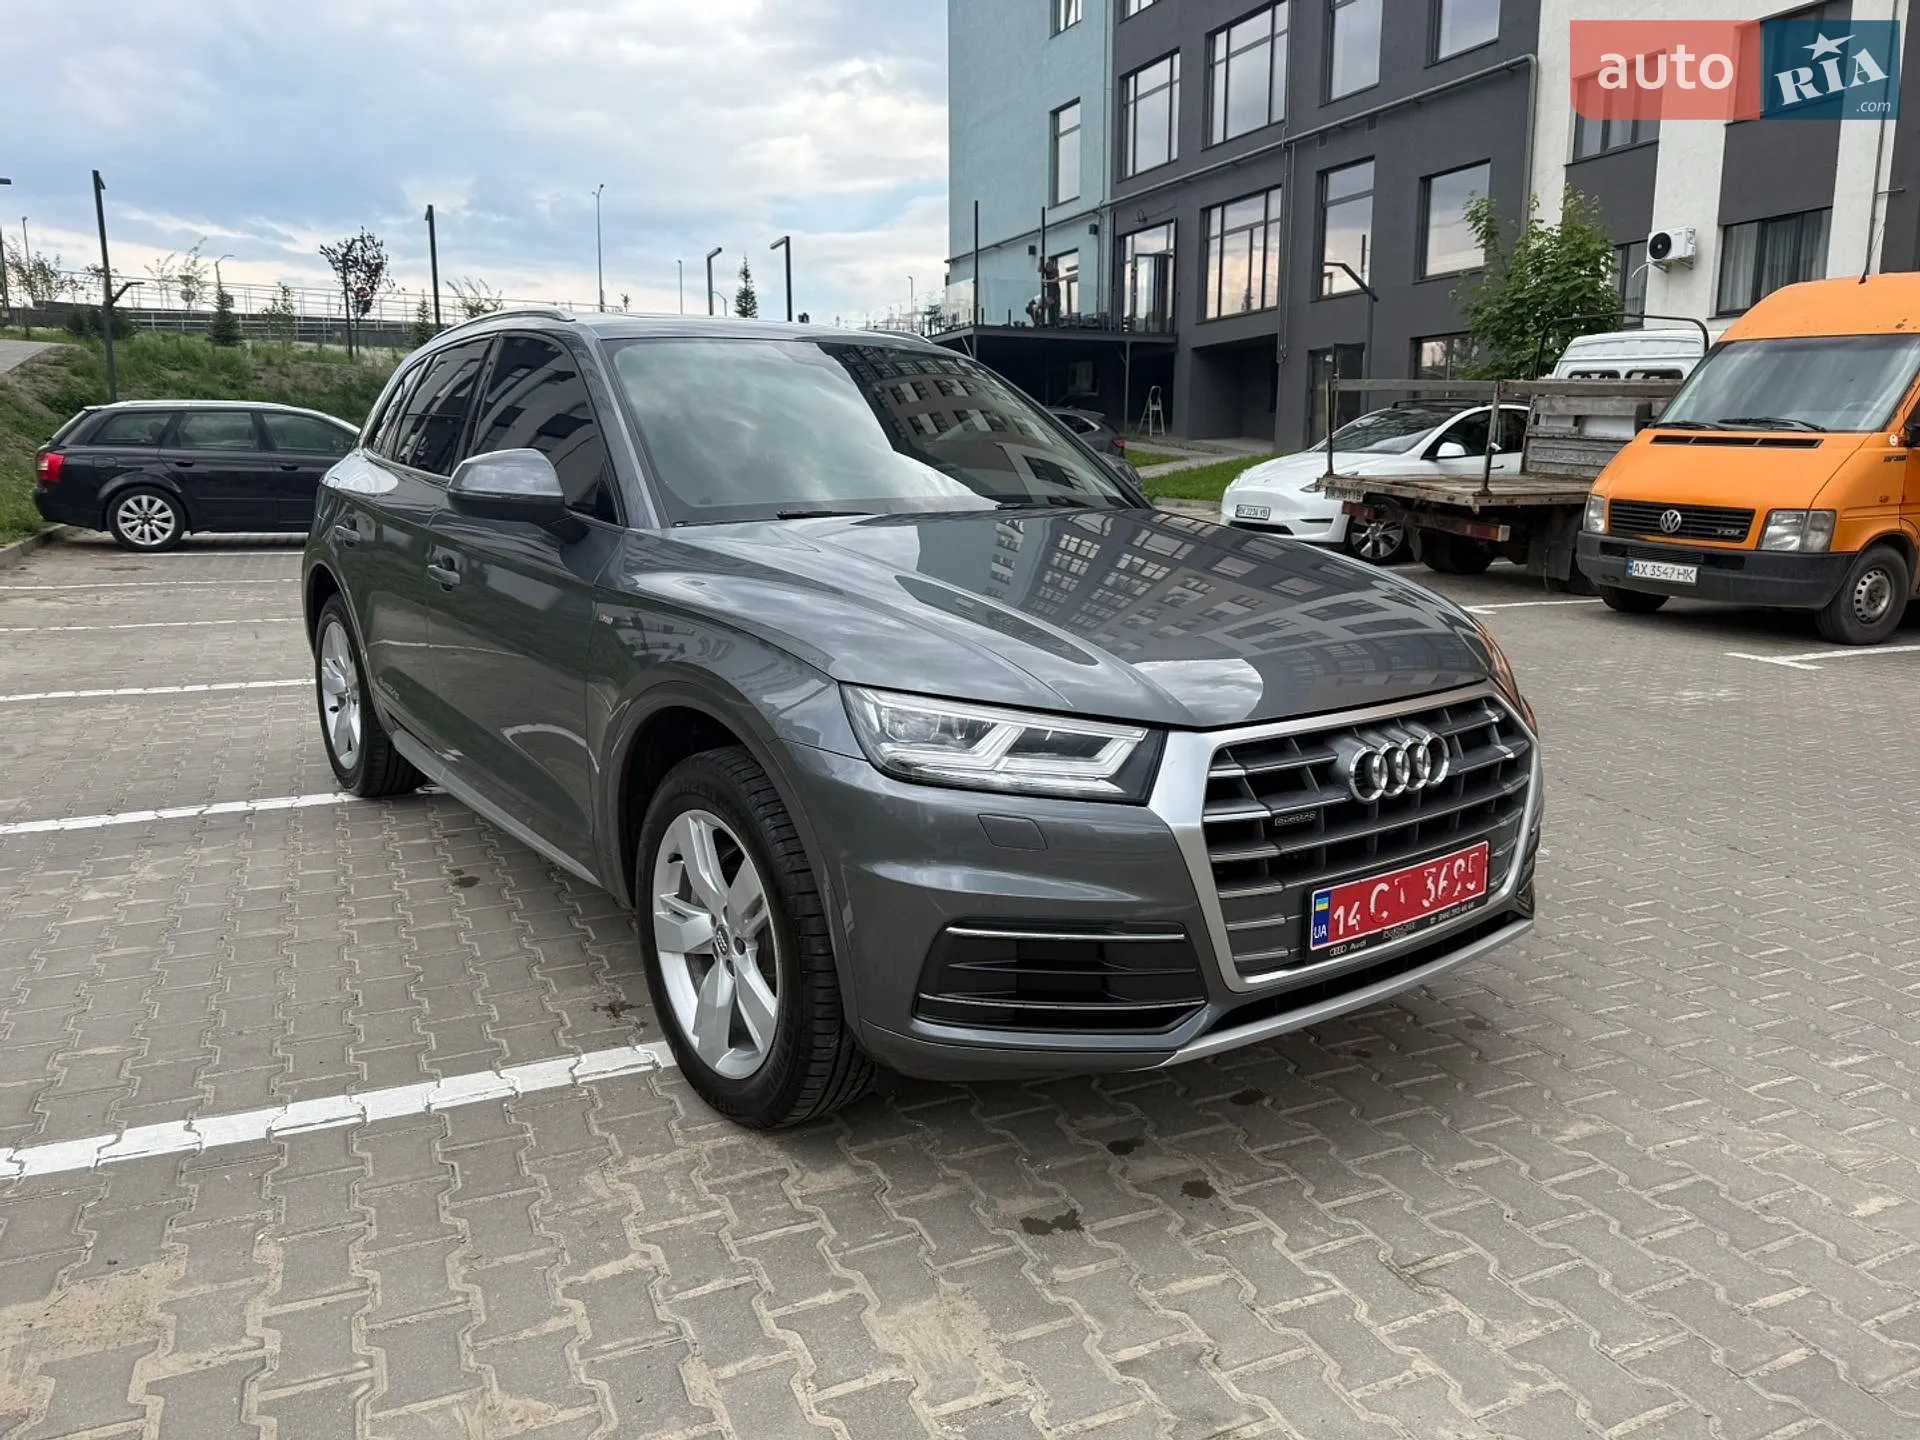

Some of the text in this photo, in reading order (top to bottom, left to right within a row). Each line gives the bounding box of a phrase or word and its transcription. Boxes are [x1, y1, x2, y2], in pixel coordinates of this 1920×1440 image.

[1633, 563, 1648, 576] AX
[1650, 565, 1676, 579] 3547
[1333, 901, 1360, 935] 14
[1313, 924, 1327, 939] UA
